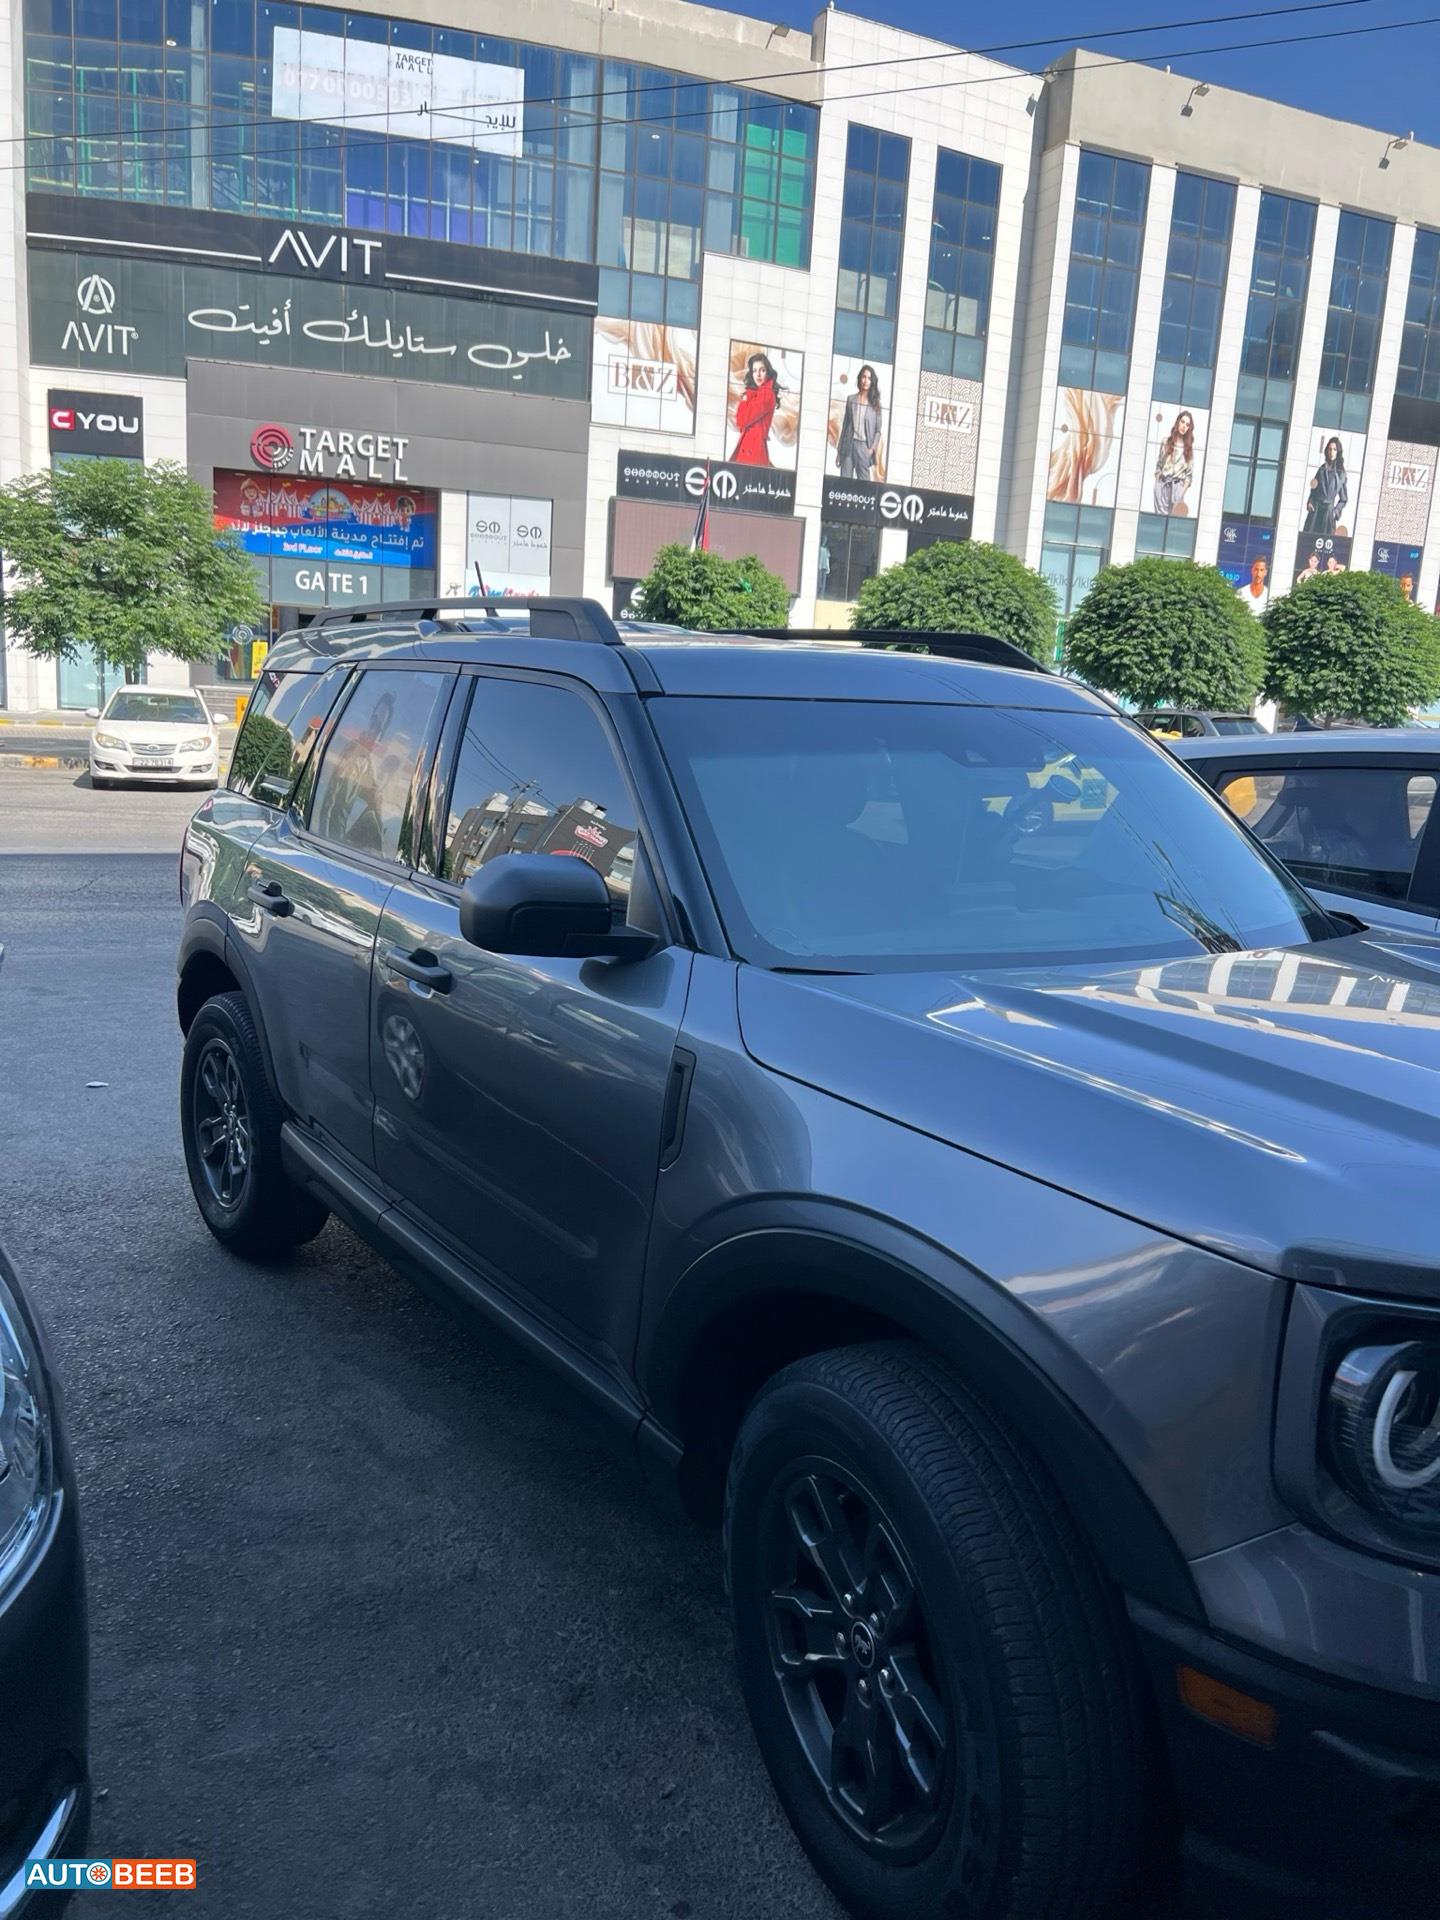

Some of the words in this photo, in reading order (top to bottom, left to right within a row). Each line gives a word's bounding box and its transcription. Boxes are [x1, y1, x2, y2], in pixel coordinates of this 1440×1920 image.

[395, 62, 433, 75] MALL
[396, 52, 433, 66] TARGET
[268, 229, 382, 275] AVIT
[467, 330, 571, 379] خلي
[614, 361, 675, 394] B&Z
[75, 411, 139, 434] YOU
[299, 427, 409, 459] TARGET
[299, 450, 409, 482] MALL
[331, 529, 367, 543] مدينة
[295, 570, 353, 593] GATE
[359, 575, 368, 595] 1
